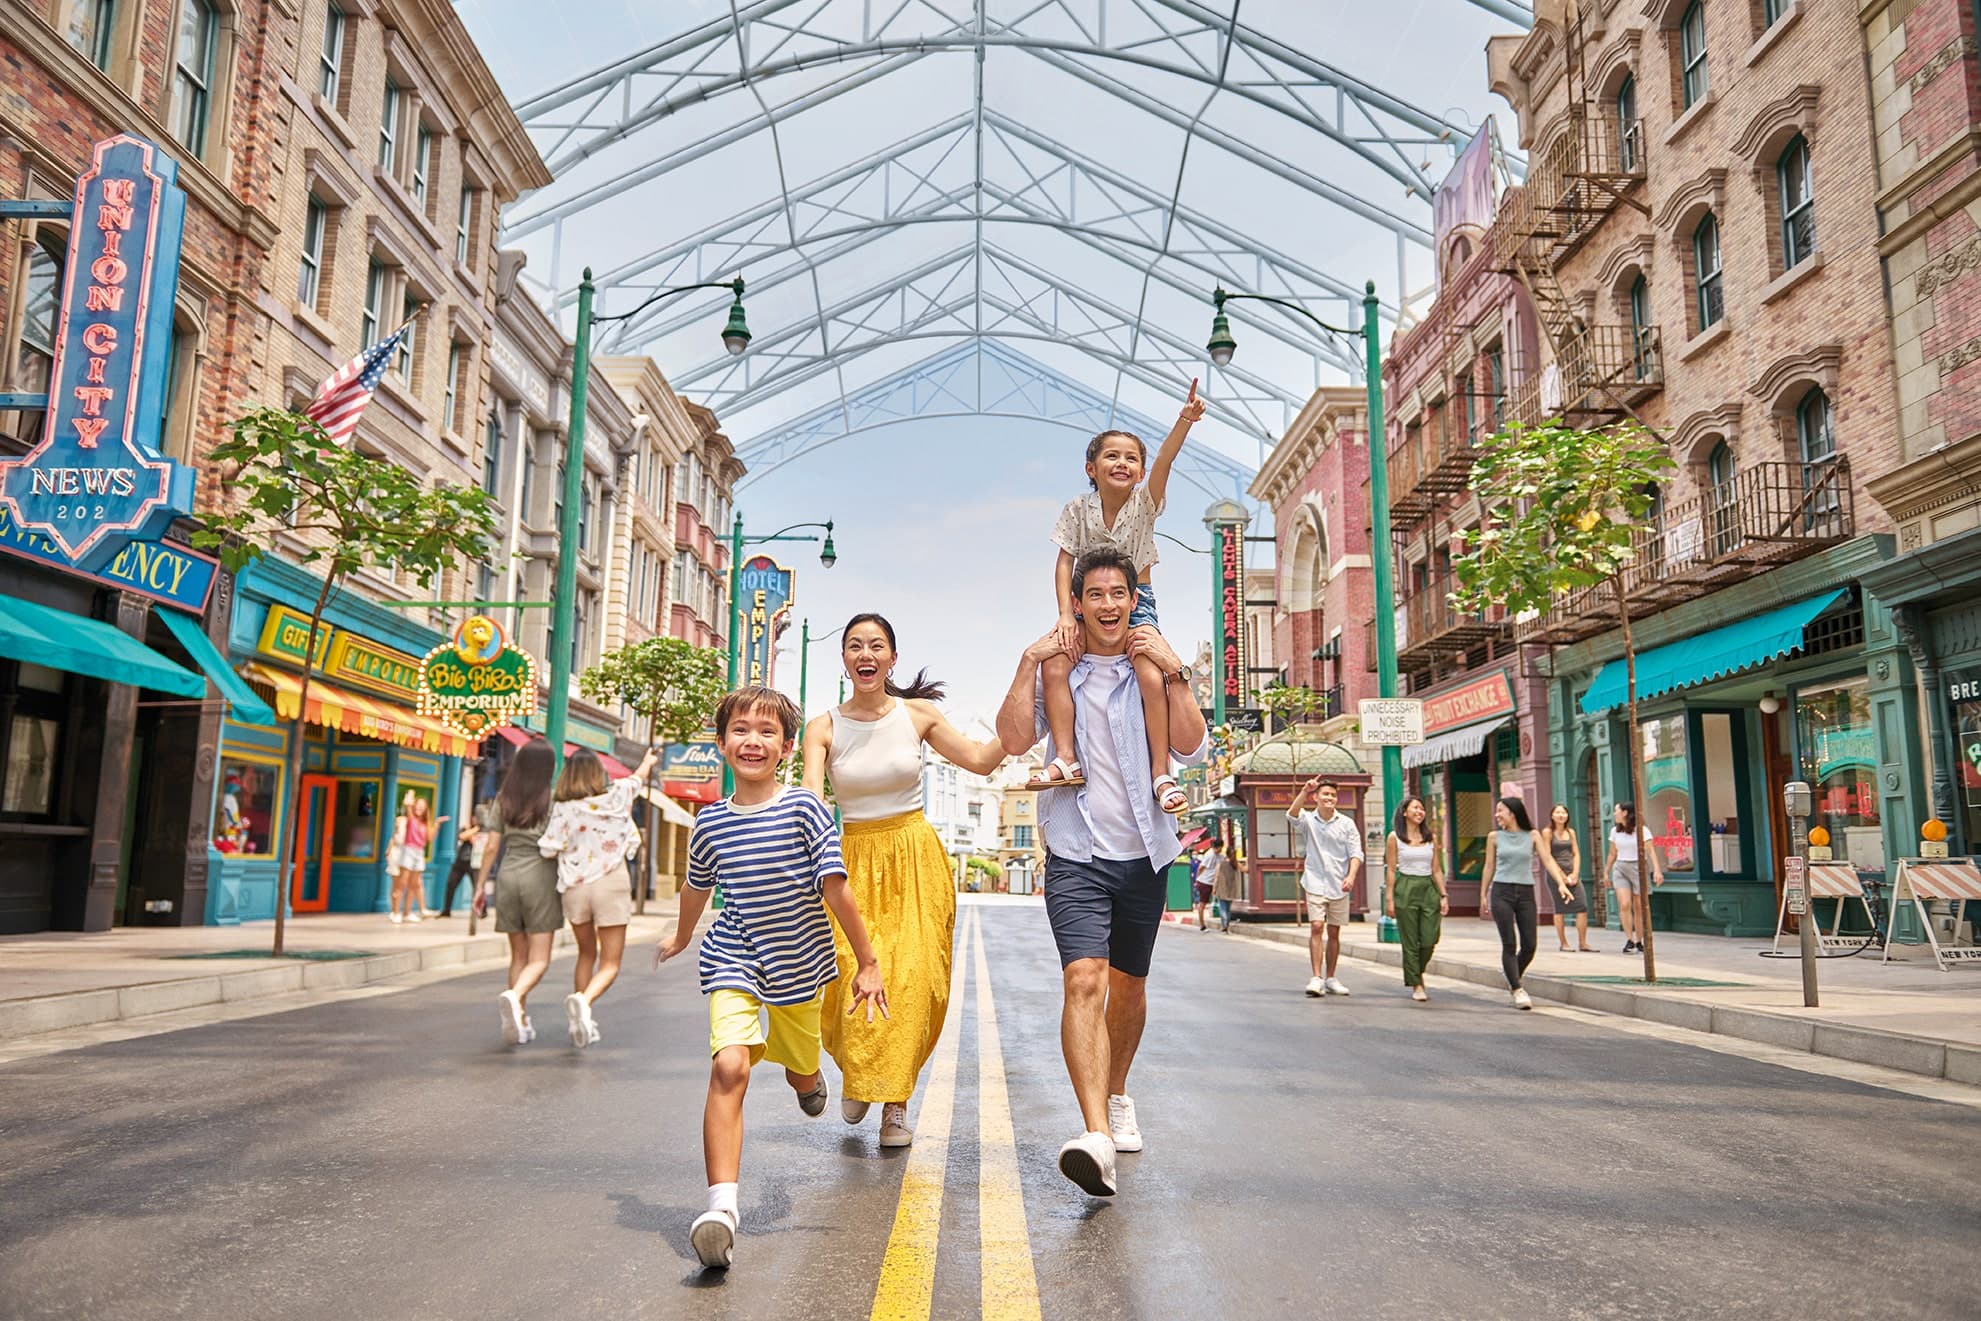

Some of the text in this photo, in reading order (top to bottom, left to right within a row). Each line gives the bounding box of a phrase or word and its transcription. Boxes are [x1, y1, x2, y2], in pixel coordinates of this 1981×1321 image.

[72, 179, 136, 449] UNION CITY
[30, 468, 136, 496] NEWS
[56, 505, 105, 519] 202
[1222, 527, 1237, 580] LIGHTS
[109, 541, 192, 596] ENCY
[1222, 587, 1238, 638] CAMERA
[345, 644, 421, 689] EMPORIU
[1224, 644, 1238, 696] ACTION
[424, 692, 527, 710] EMPORIUM
[1950, 680, 1980, 701] BRE
[1362, 702, 1419, 714] UNNECESSARY
[1379, 716, 1406, 728] NOISE
[1368, 730, 1418, 741] PROHIBITED
[1941, 950, 1981, 960] NEW YOR
